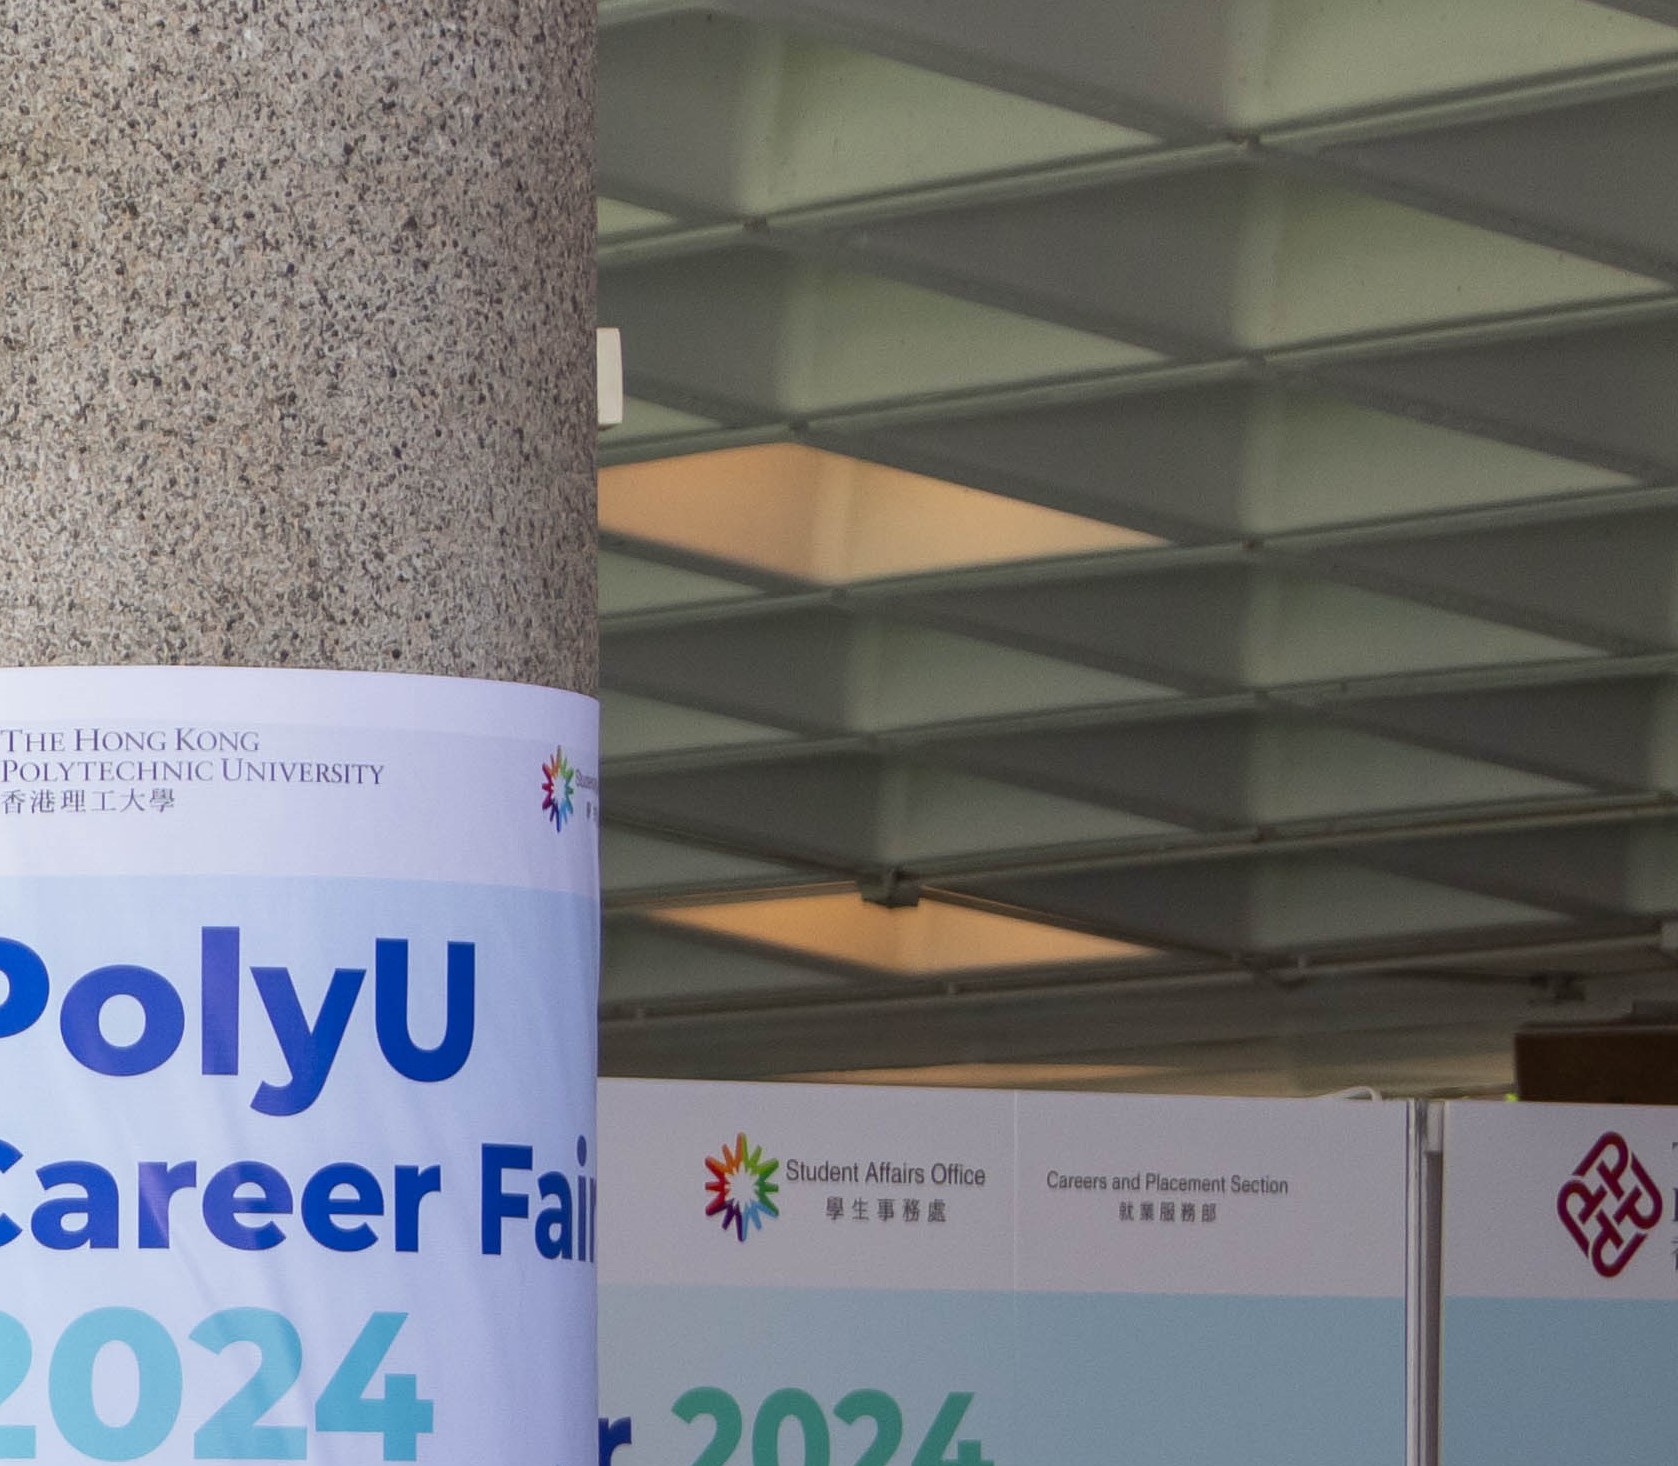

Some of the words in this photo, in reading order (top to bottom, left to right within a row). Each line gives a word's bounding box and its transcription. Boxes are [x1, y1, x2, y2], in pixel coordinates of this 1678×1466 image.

[0, 728, 64, 752] THE
[75, 729, 166, 752] HONG
[176, 729, 259, 753] KONG
[1, 759, 216, 785] POLYTECHNIC
[224, 760, 384, 786] UNIVERSITY
[0, 789, 176, 814] 香港理工大學
[786, 1160, 859, 1186] Student
[865, 1162, 924, 1187] Affairs
[930, 1163, 986, 1187] Office
[1047, 1171, 1107, 1194] Careers
[1112, 1173, 1140, 1194] and
[1146, 1173, 1225, 1194] Placement
[1231, 1174, 1289, 1196] Section
[826, 1197, 947, 1223] 學生事務處
